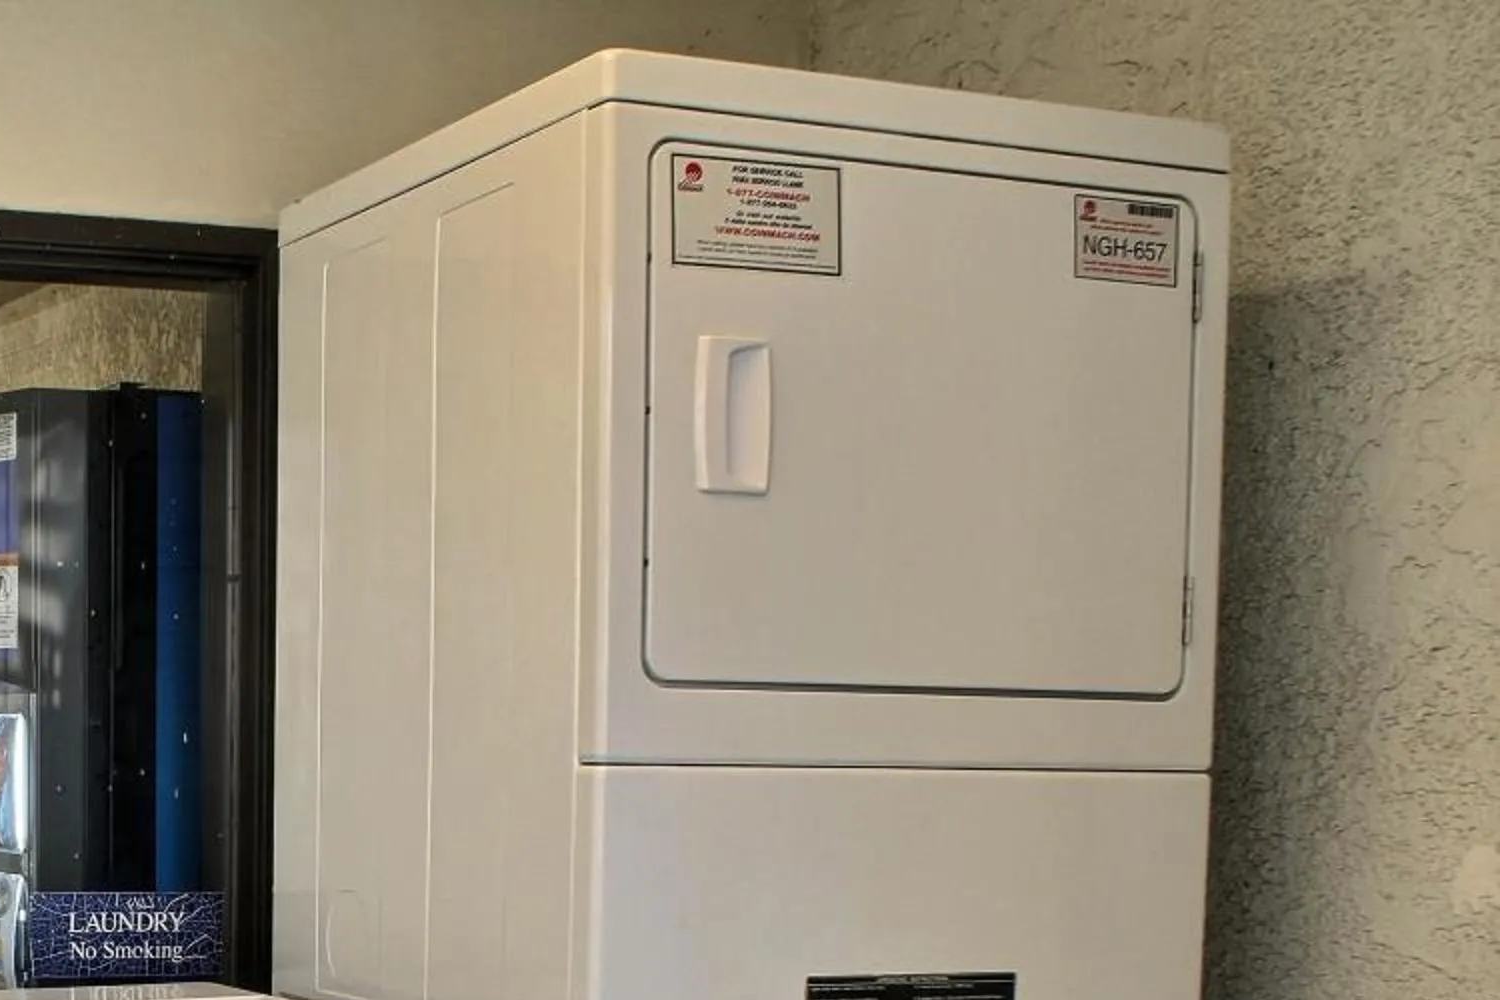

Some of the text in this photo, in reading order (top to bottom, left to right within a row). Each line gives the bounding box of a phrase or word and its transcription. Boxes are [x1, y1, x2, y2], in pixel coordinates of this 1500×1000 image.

[1083, 235, 1168, 262] NGH-657
[68, 911, 186, 933] LAUNDRY
[69, 939, 183, 962] No Smoking
